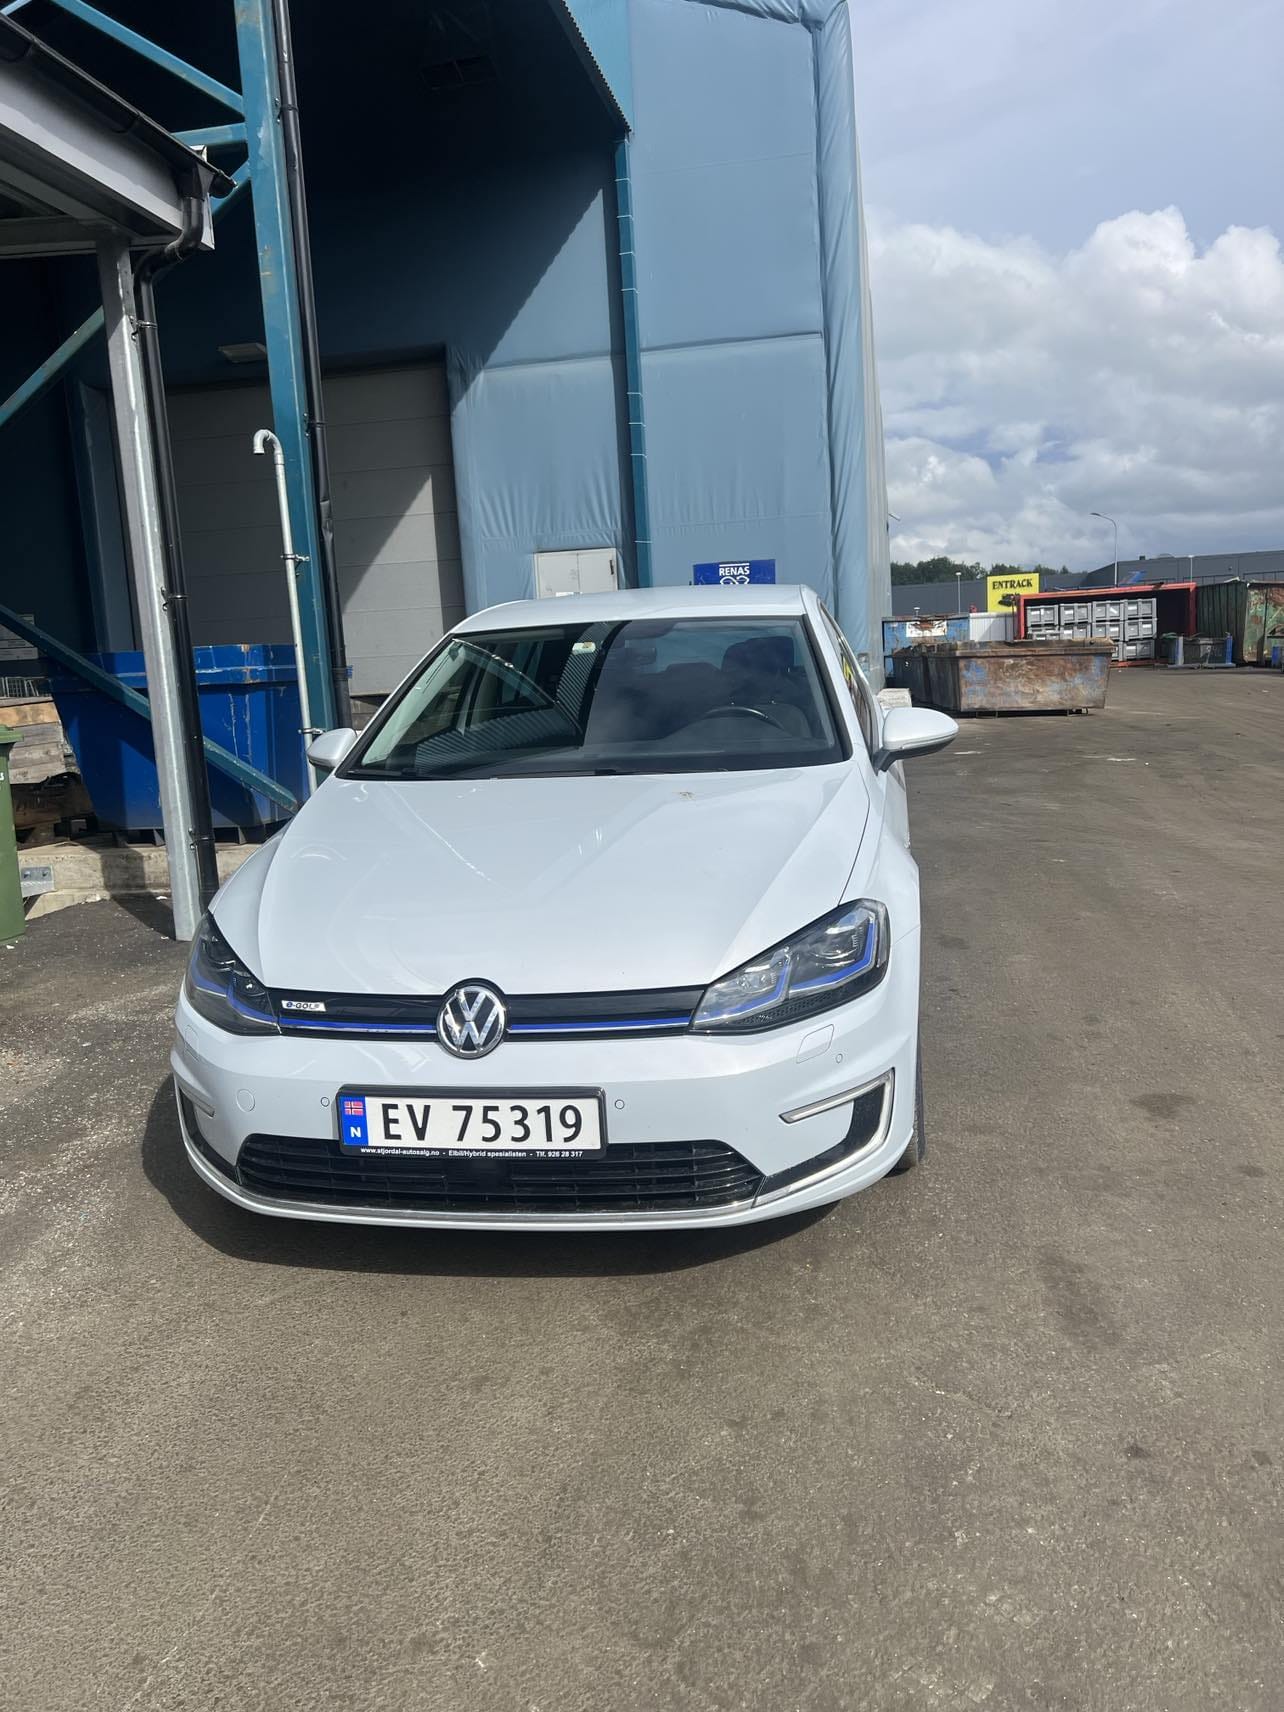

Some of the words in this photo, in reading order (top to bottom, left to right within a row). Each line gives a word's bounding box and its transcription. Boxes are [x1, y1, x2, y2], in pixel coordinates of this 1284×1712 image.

[719, 566, 750, 576] RENAS
[992, 578, 1032, 590] ENTRACK
[381, 1103, 431, 1141] EV
[452, 1105, 582, 1143] 75319
[350, 1127, 361, 1138] N
[360, 1148, 440, 1156] www.stjordal-autosalg.no
